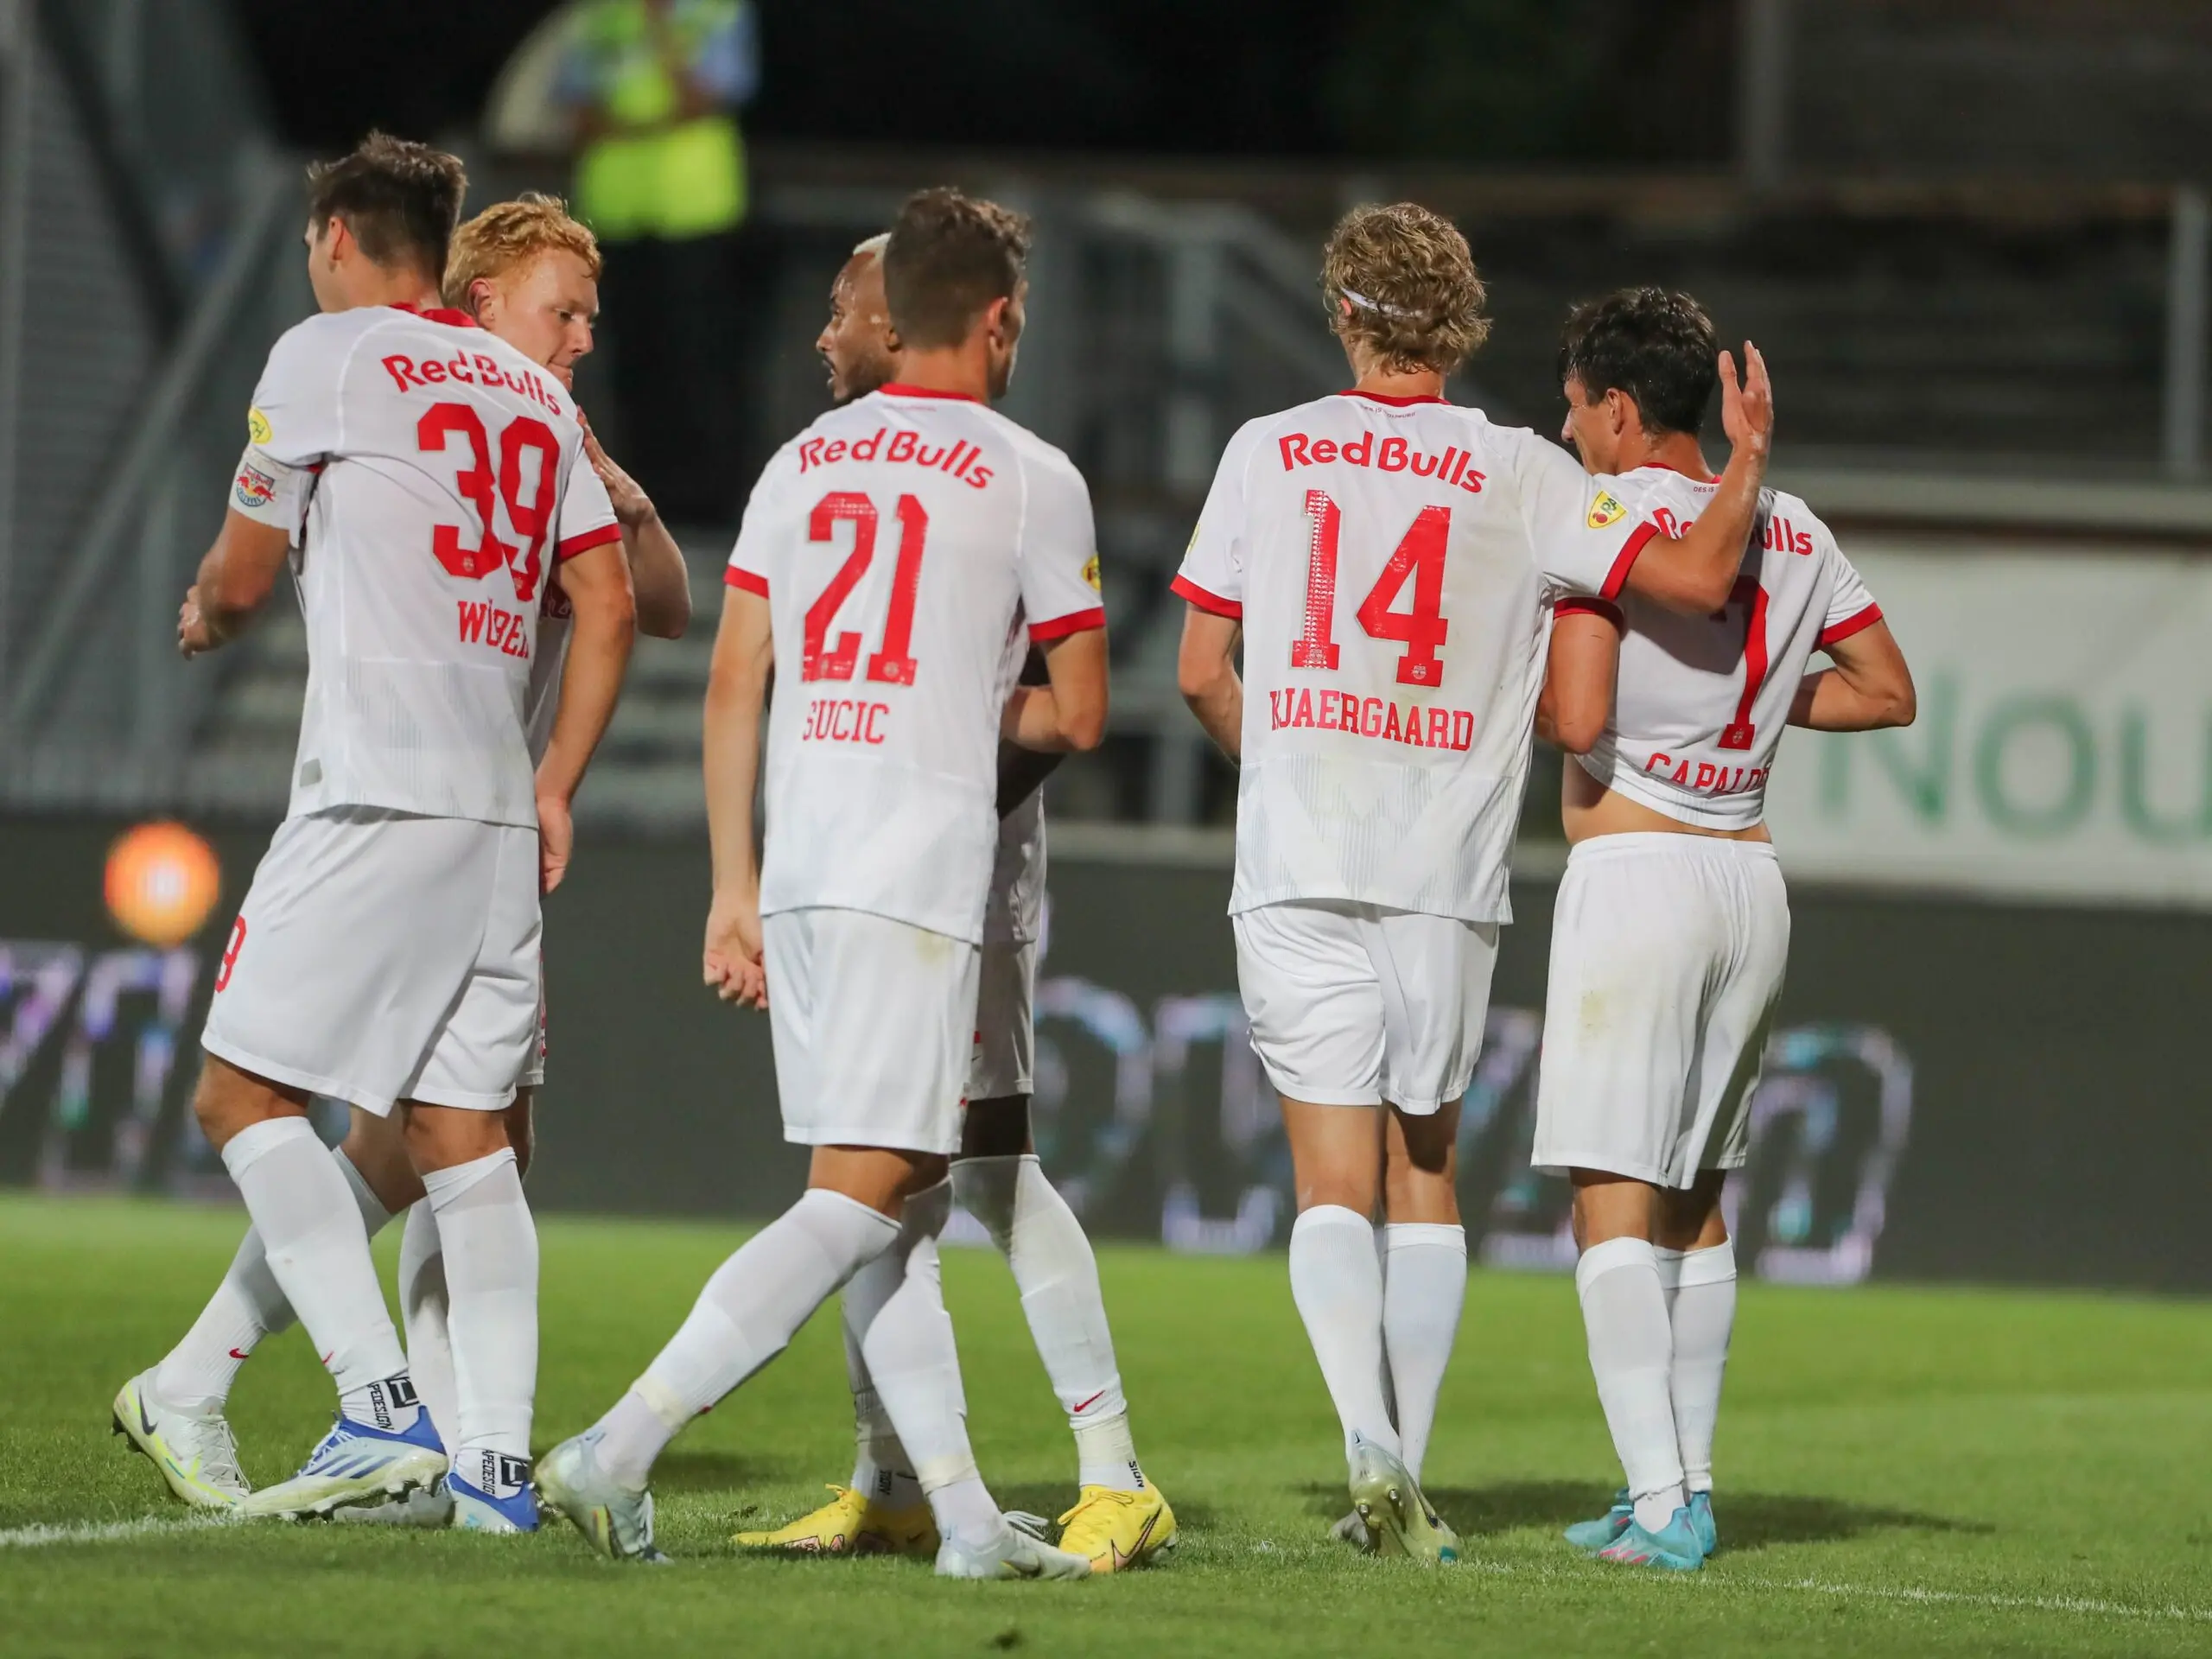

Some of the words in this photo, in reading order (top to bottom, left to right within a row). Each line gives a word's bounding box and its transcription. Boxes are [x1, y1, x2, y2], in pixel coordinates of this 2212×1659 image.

[416, 402, 561, 602] 39
[802, 491, 930, 687] 21
[1292, 489, 1452, 688] 14
[802, 699, 891, 745] SUCIC
[1269, 687, 1474, 752] KJAERGAARD
